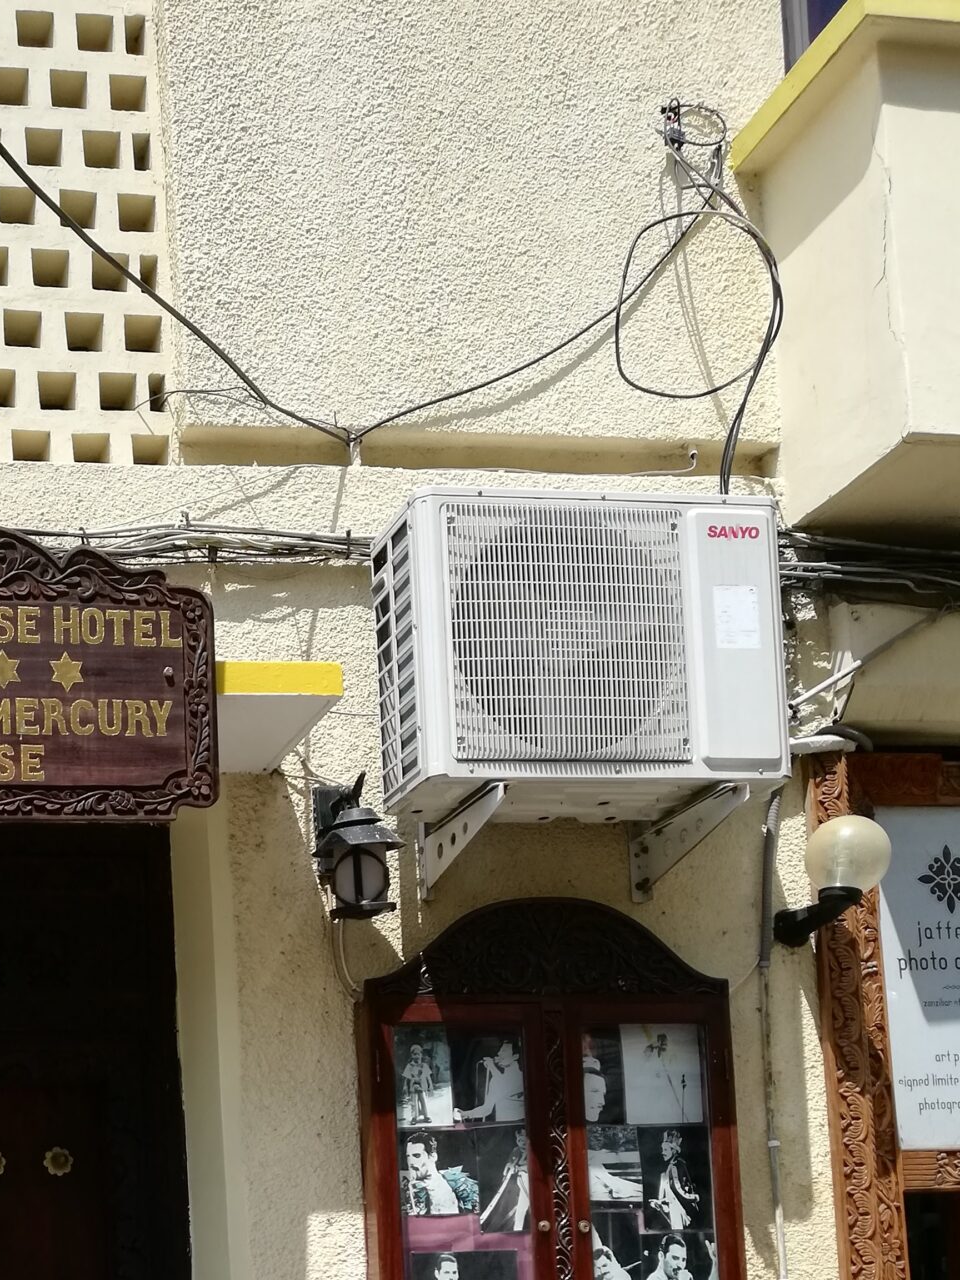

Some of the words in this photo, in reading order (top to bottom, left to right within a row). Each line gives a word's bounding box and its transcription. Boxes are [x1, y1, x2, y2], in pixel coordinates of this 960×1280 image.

[707, 525, 760, 539] SANYO
[53, 605, 183, 648] HOTEL
[896, 948, 948, 980] photo
[934, 1049, 951, 1063] art
